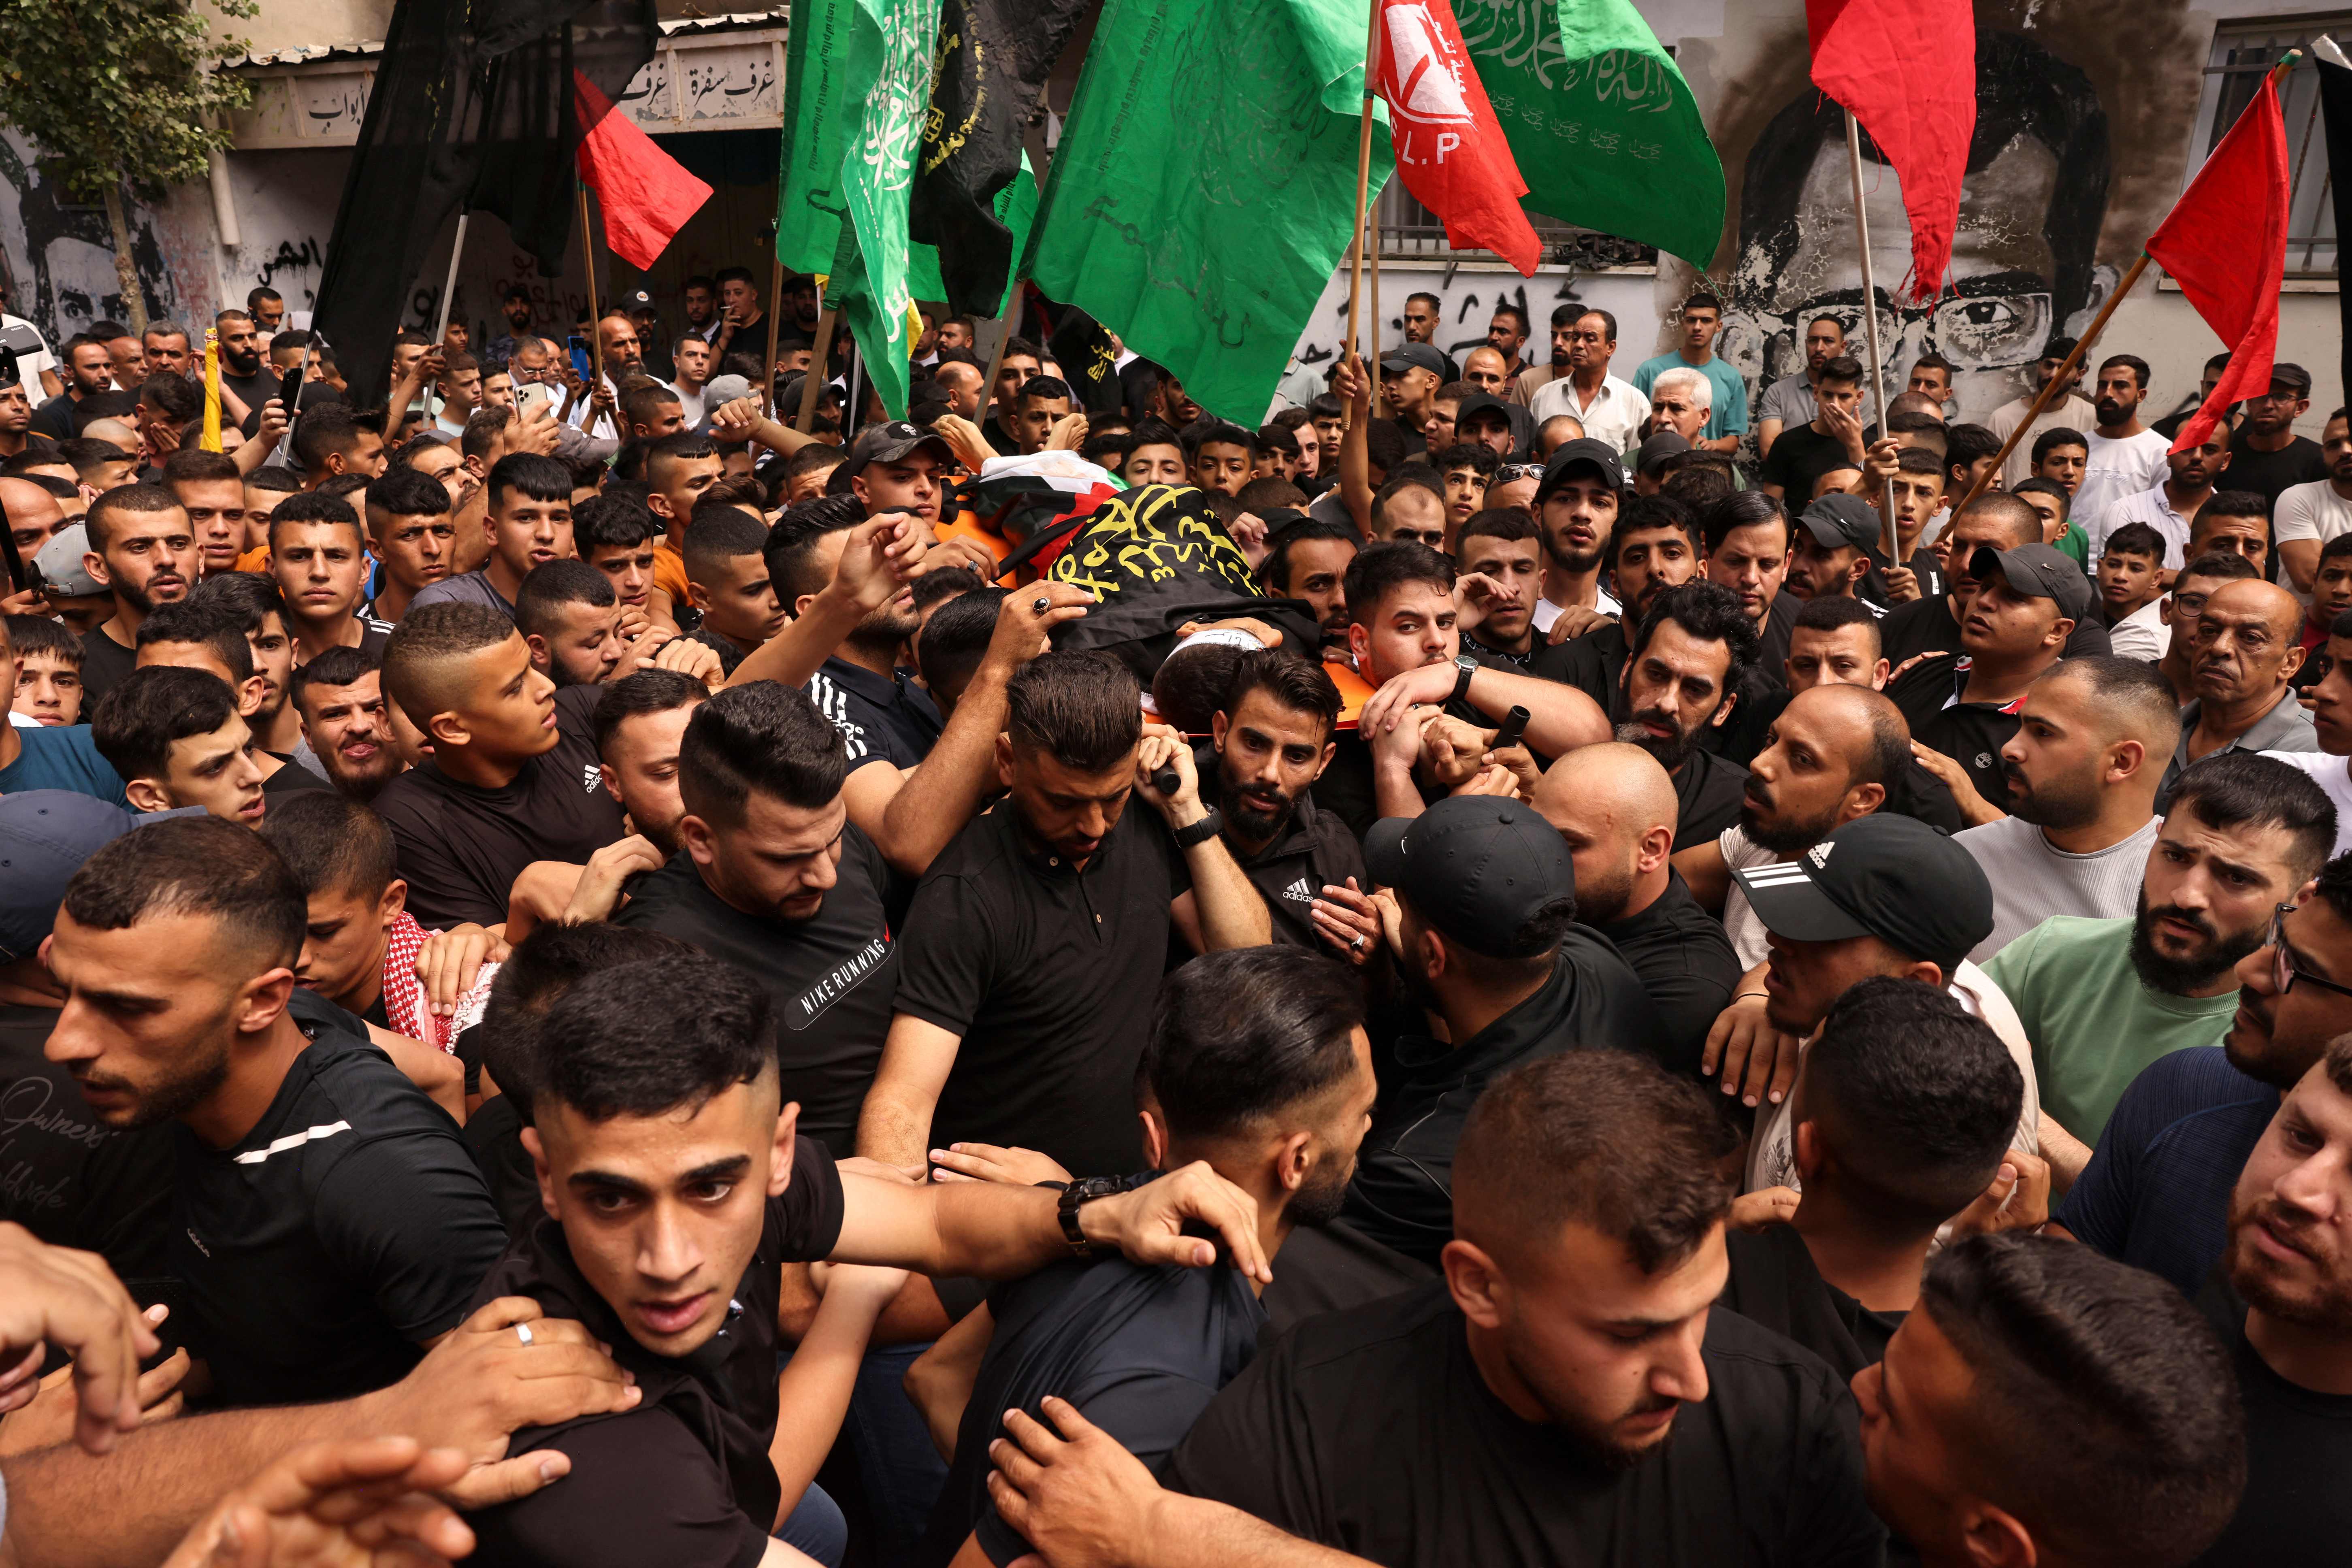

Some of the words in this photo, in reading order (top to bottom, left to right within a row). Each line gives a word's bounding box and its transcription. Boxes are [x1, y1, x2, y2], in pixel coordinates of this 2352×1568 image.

[689, 66, 727, 107] سفرة
[725, 60, 775, 104] غرف
[1283, 891, 1313, 903] adidas
[801, 979, 835, 1015] NIKE
[832, 939, 885, 989] RUNNING
